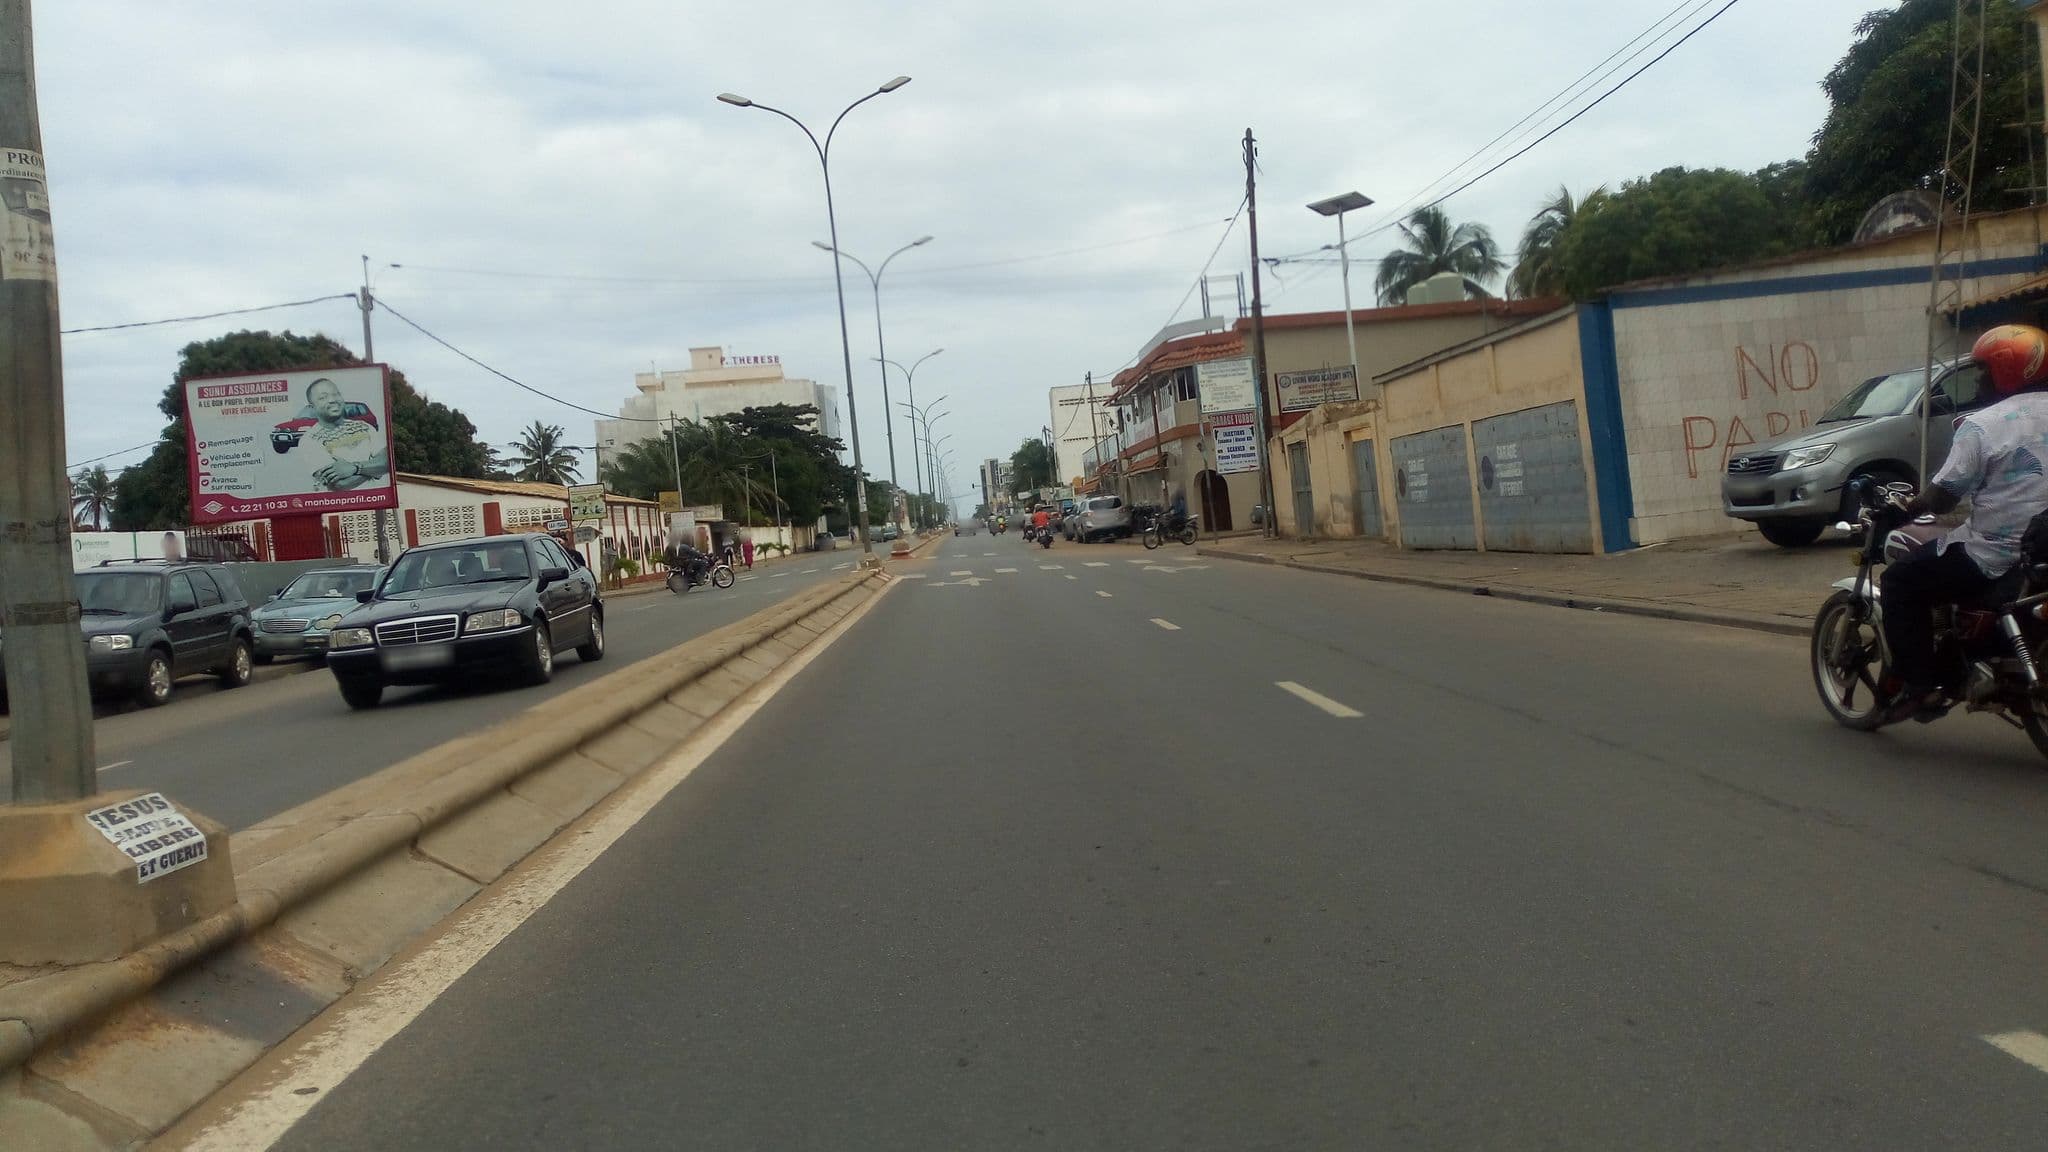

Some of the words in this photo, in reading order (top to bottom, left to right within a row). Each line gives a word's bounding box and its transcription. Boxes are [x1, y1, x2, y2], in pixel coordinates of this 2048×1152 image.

[732, 355, 780, 365] THERESE
[1735, 342, 1818, 400] NO
[203, 386, 226, 398] SUNU
[228, 381, 282, 395] ASSURANCES
[211, 399, 223, 407] BON
[224, 398, 243, 406] PROFIL
[245, 397, 260, 405] POUR
[221, 407, 239, 415] VOTRE
[1211, 414, 1234, 426] GARAGE
[1234, 413, 1254, 425] TURBO
[208, 436, 254, 448] Remorquage
[210, 458, 262, 469] remplacement
[304, 494, 386, 507] monbonprofil.com
[126, 827, 199, 858] LIBERE
[140, 858, 156, 878] ET
[159, 840, 205, 870] GUERIT
